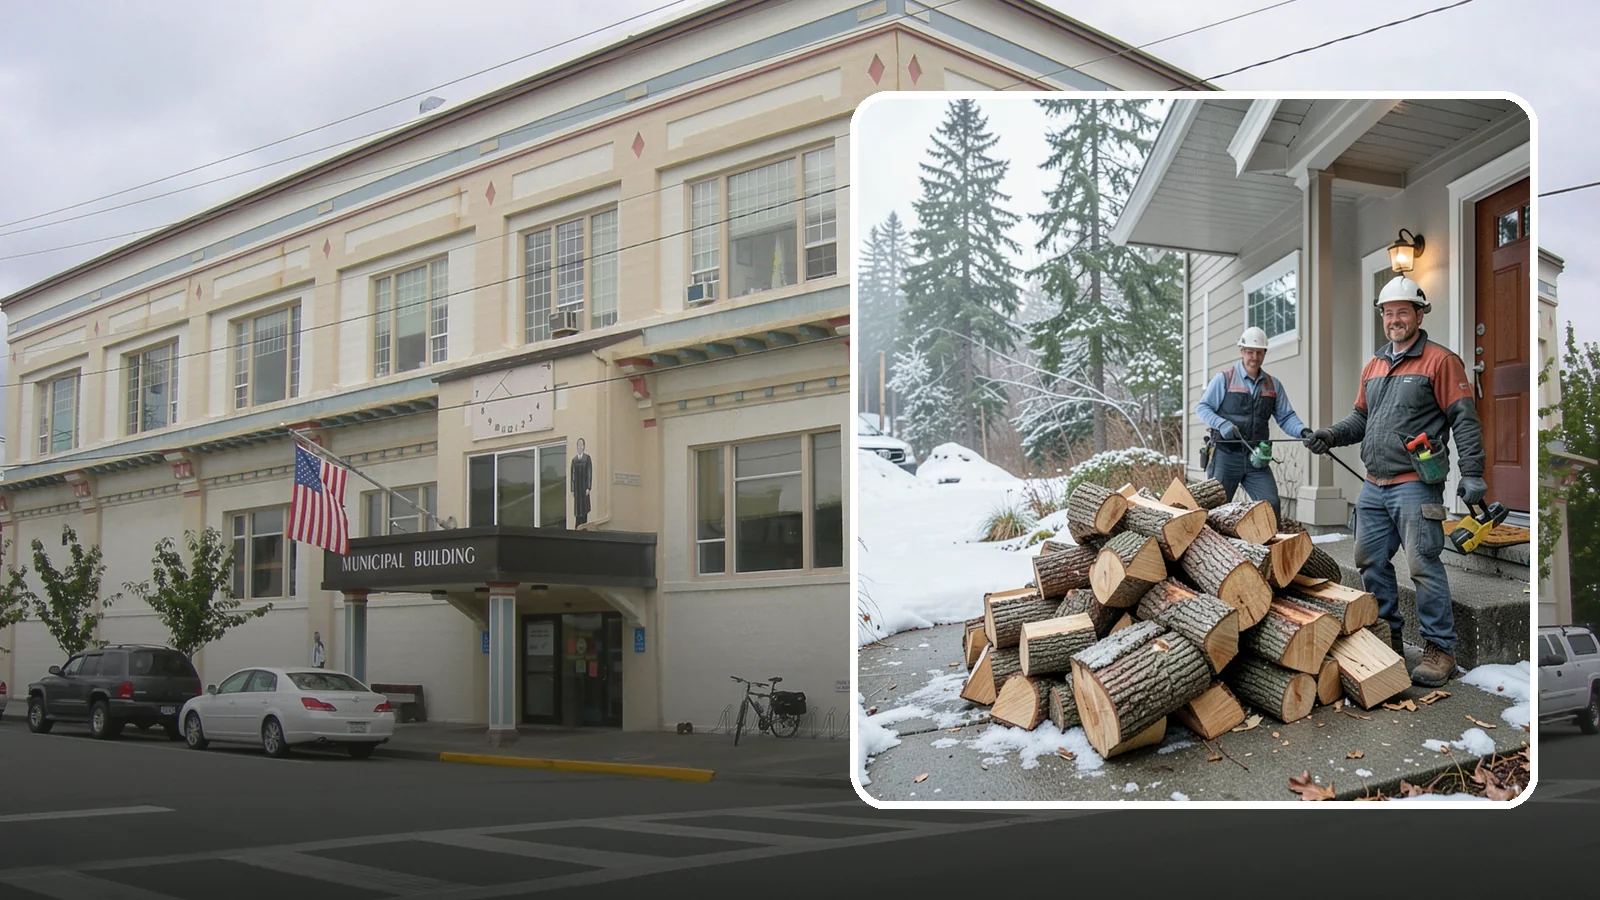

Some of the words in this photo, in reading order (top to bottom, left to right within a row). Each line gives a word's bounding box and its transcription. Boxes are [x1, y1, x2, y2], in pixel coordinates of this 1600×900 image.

[475, 389, 479, 398] 7
[480, 406, 485, 415] 8
[536, 402, 540, 410] 4
[487, 417, 492, 426] 9
[529, 413, 533, 422] 3
[494, 423, 500, 432] 10
[521, 420, 526, 428] 2
[507, 425, 513, 434] 12
[342, 552, 405, 572] MUNICIPAL
[414, 546, 475, 567] BUILDING
